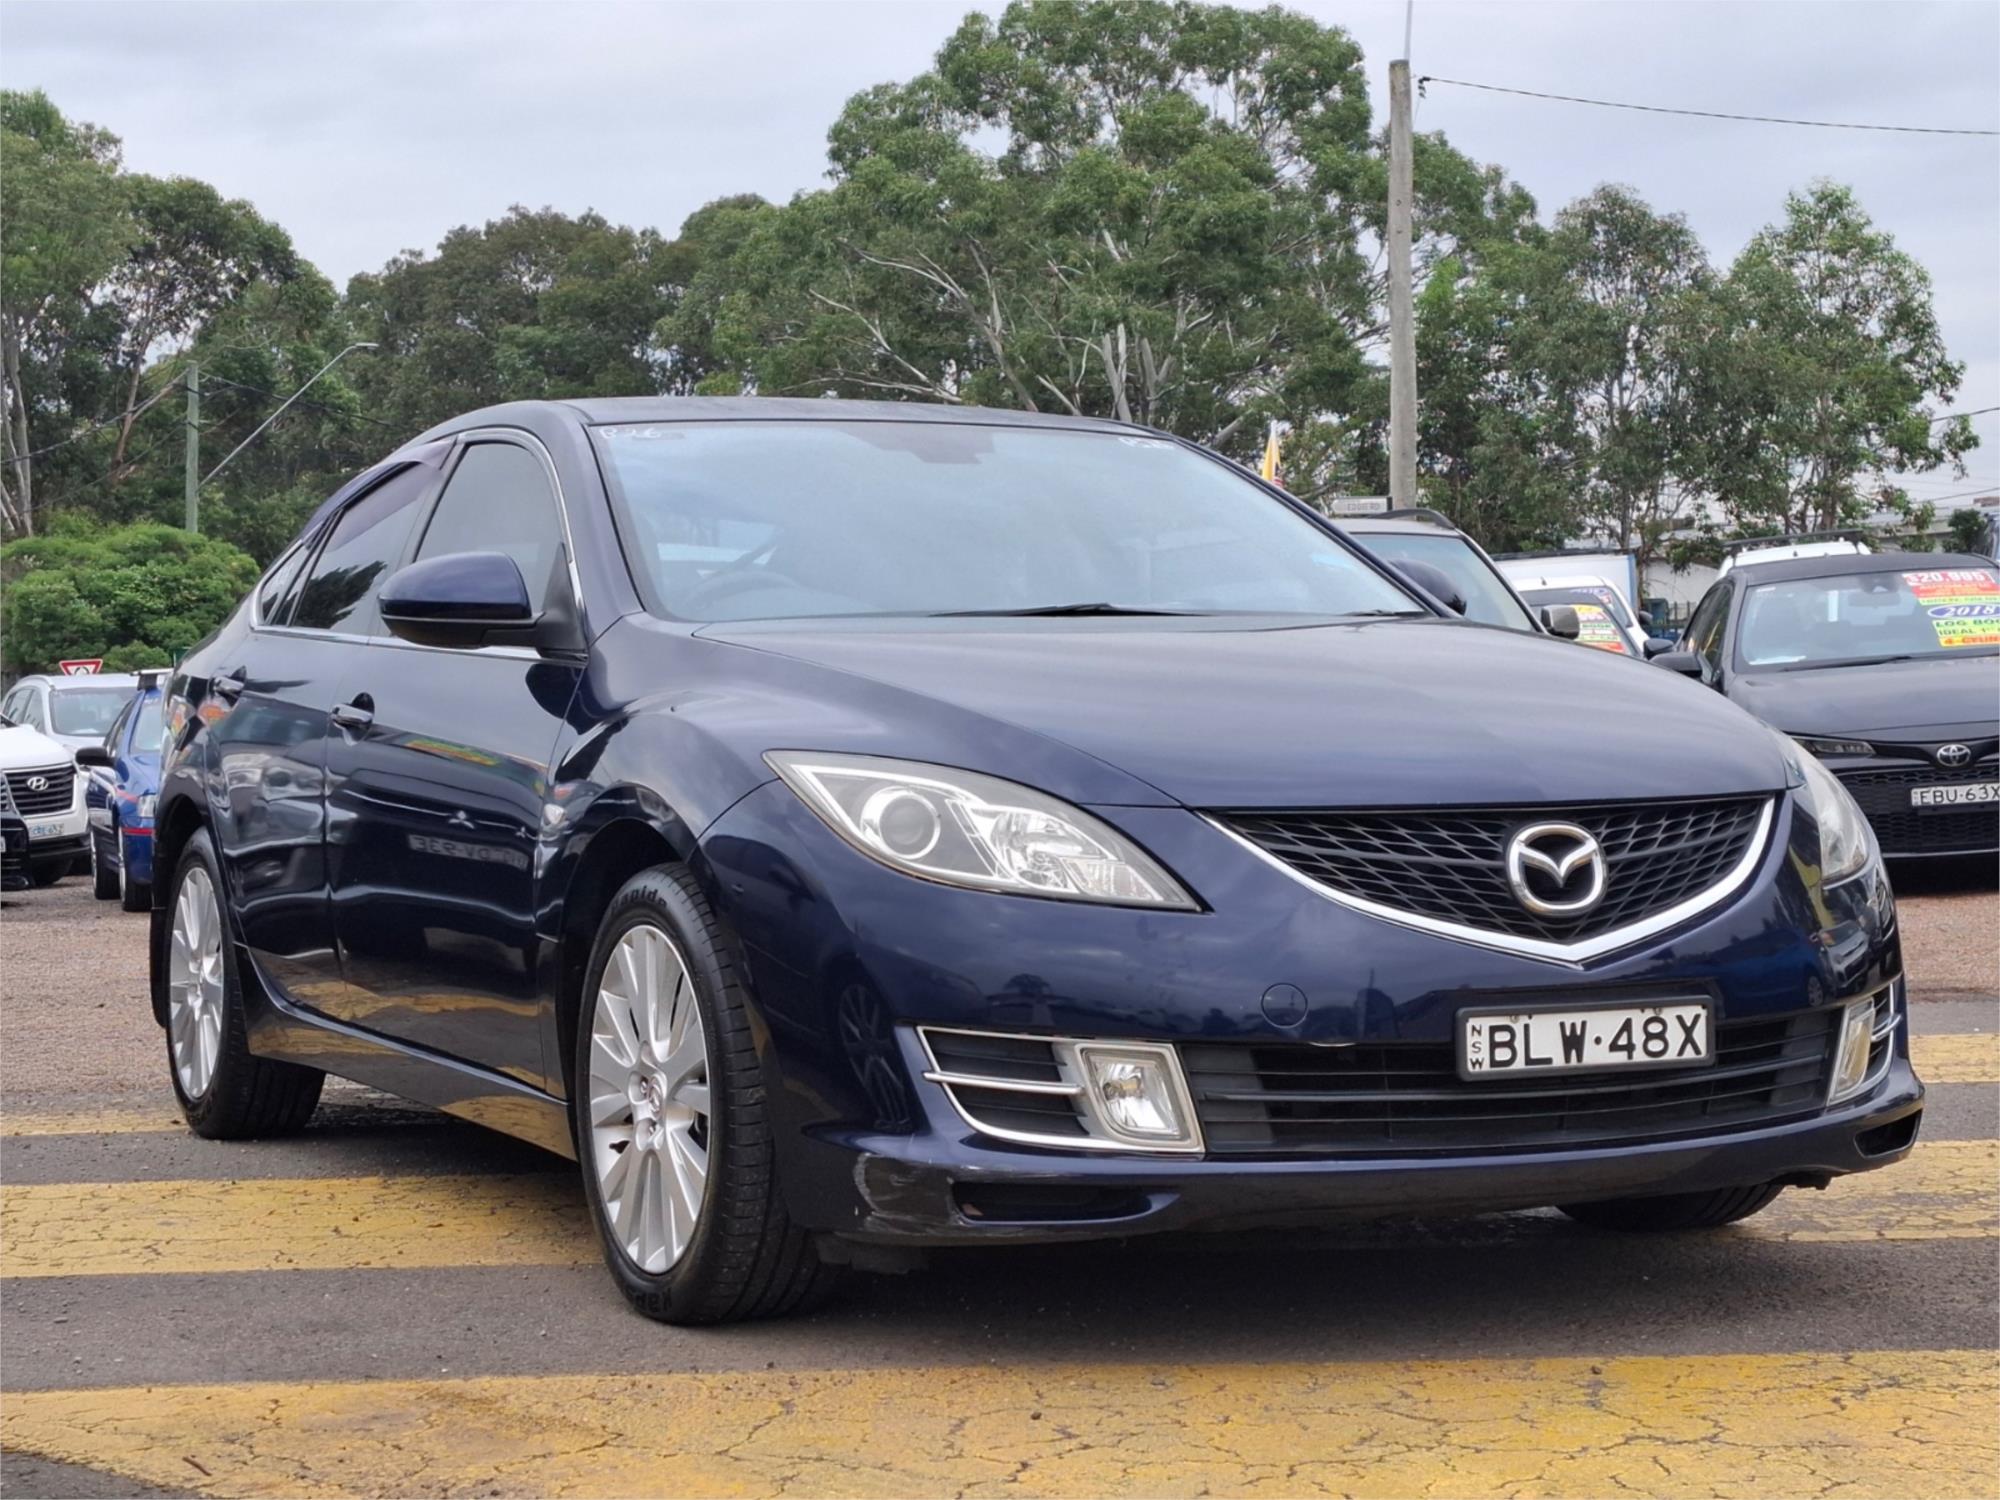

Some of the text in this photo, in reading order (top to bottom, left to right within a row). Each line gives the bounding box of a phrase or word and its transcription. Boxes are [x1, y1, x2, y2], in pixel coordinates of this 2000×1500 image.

[1944, 605, 1995, 617] 2018
[1936, 620, 1967, 628] LOG
[1939, 628, 1975, 636] IDEAL
[1470, 1024, 1485, 1070] NSW
